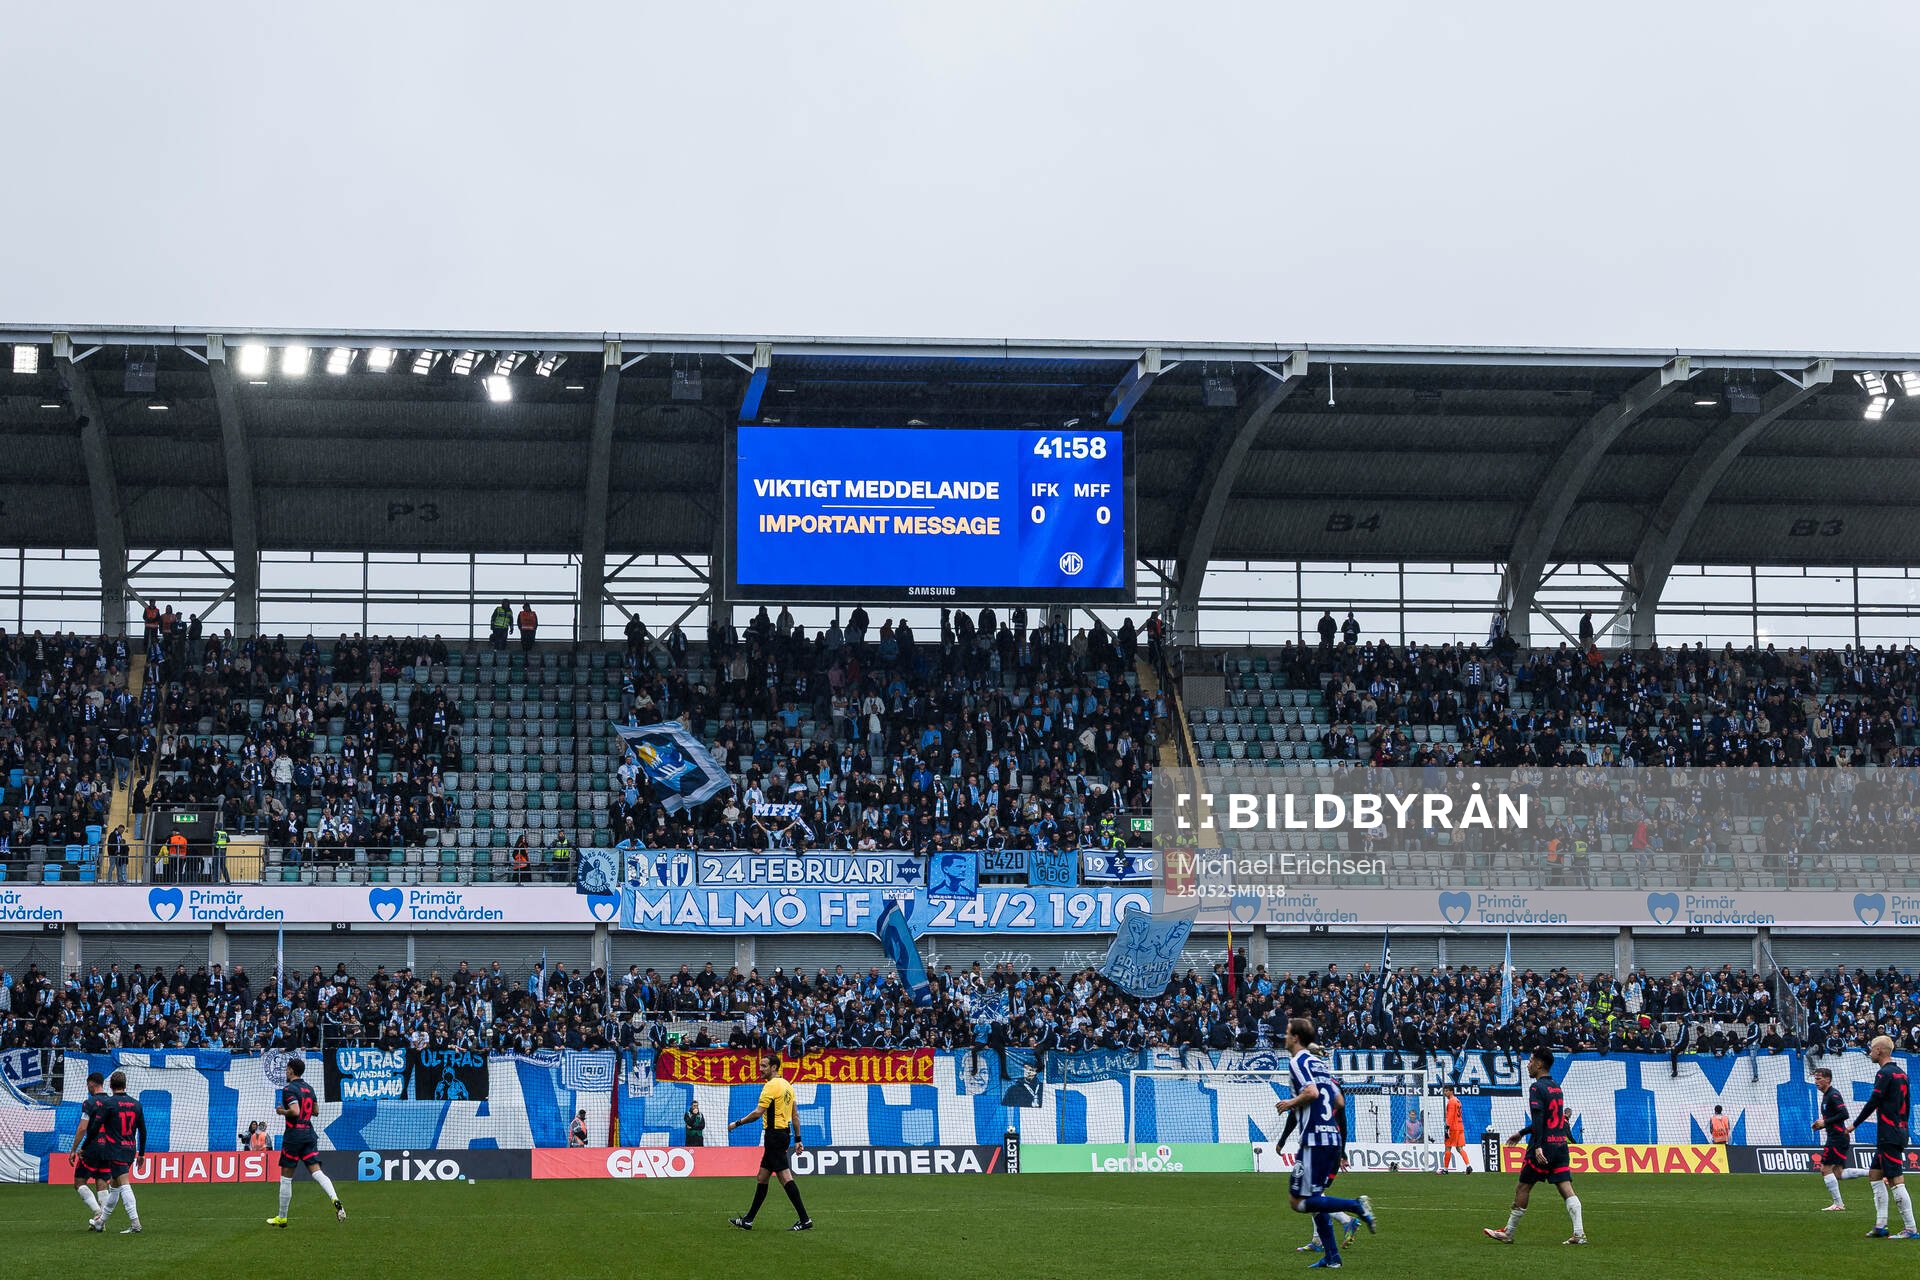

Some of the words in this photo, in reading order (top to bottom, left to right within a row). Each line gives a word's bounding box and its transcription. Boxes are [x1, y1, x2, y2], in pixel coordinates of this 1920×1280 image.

[1033, 437, 1107, 459] 41:58
[753, 479, 841, 498] VIKTIGT
[845, 479, 1000, 500] MEDDELANDE
[1031, 483, 1060, 498] IFK
[1074, 483, 1111, 498] MFF
[387, 502, 440, 521] P3
[1031, 505, 1046, 524] 0
[1096, 506, 1111, 525] 0
[759, 514, 890, 534] IMPORTANT
[893, 515, 1001, 535] MESSAGE
[908, 586, 957, 597] SAMSUNG
[749, 857, 892, 883] FEBRUARI
[901, 867, 917, 875] 1910
[984, 852, 1024, 870] 6420
[1086, 857, 1105, 872] 19
[1037, 867, 1069, 883] GBG
[190, 890, 243, 904] Primär
[410, 890, 462, 904] Primär
[1267, 892, 1319, 908] Primär
[1477, 893, 1528, 909] Primär
[1685, 894, 1735, 909] Primär
[189, 905, 284, 920] Tandvården
[409, 905, 503, 920] Tandvården
[633, 887, 808, 928] MALMÖ
[819, 892, 870, 927] FF
[927, 892, 1037, 928] 24/2
[1050, 892, 1152, 928] 1910
[1267, 908, 1358, 924] Tandvården
[1477, 908, 1567, 924] Tandvården
[1684, 910, 1775, 925] Tandvården
[340, 1049, 404, 1071] ULTRAS
[420, 1049, 484, 1068] ULTRAS
[664, 1048, 762, 1082] Terra
[582, 1066, 604, 1075] 1910
[1340, 1052, 1521, 1085] ULTRAS
[1382, 1086, 1422, 1095] BLOCK
[1434, 1085, 1480, 1095] MLMÖ
[300, 1097, 313, 1121] 19
[1320, 1087, 1333, 1121] 3
[119, 1111, 137, 1137] 17
[606, 1149, 695, 1179] GARO
[791, 1150, 983, 1175] OPTIMERA
[1008, 1138, 1018, 1174] SELECT
[1489, 1138, 1499, 1172] SELECT
[1503, 1145, 1721, 1174] BGGMAX
[1762, 1148, 1810, 1171] weber
[133, 1155, 263, 1180] UHAUS
